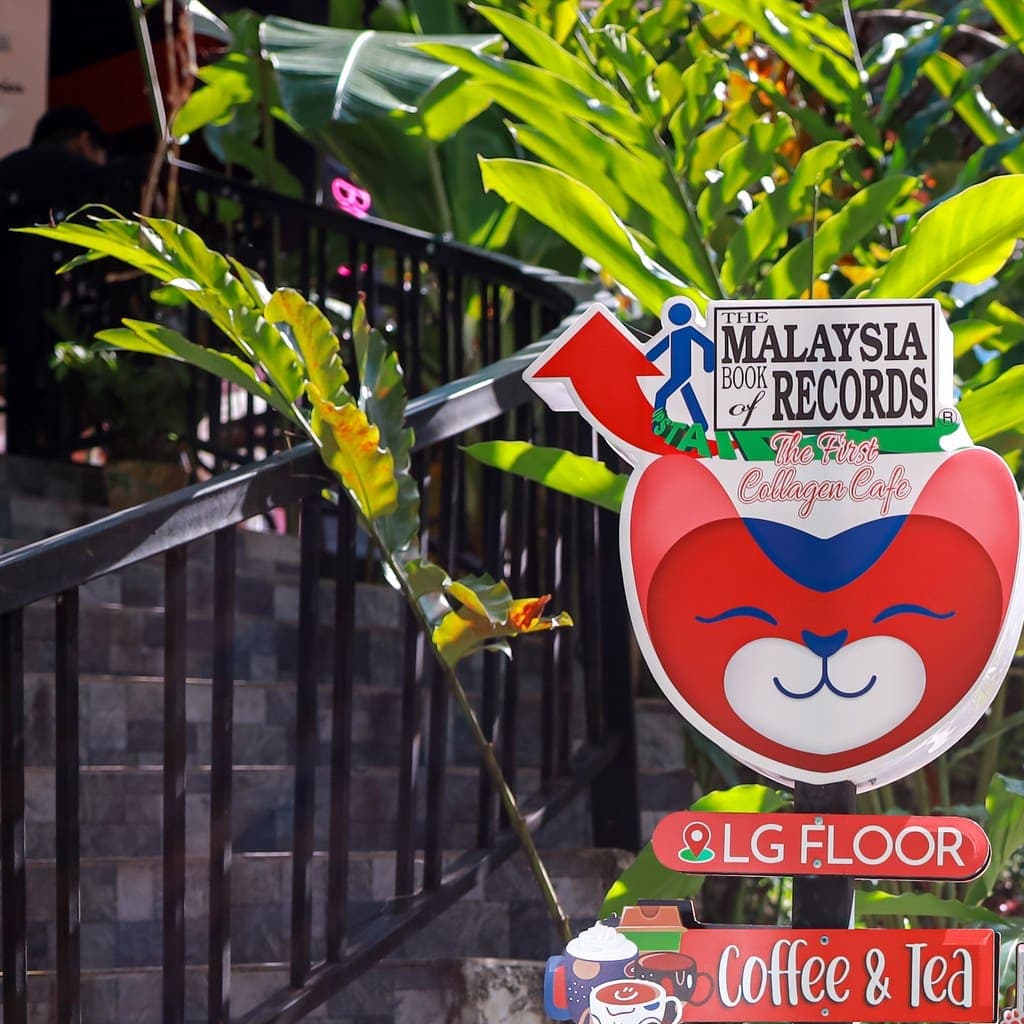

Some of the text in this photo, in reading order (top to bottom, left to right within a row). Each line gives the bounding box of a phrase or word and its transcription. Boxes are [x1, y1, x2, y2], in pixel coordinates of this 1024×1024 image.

[721, 312, 768, 324] THE
[721, 323, 927, 363] MALAYSIA
[722, 366, 767, 389] BOOK
[729, 367, 928, 426] of RECORDS
[770, 431, 879, 465] The First
[738, 465, 912, 518] Collagen Cafe
[723, 823, 965, 867] LG FLOOR
[719, 939, 972, 1008] Coffee & Tea
